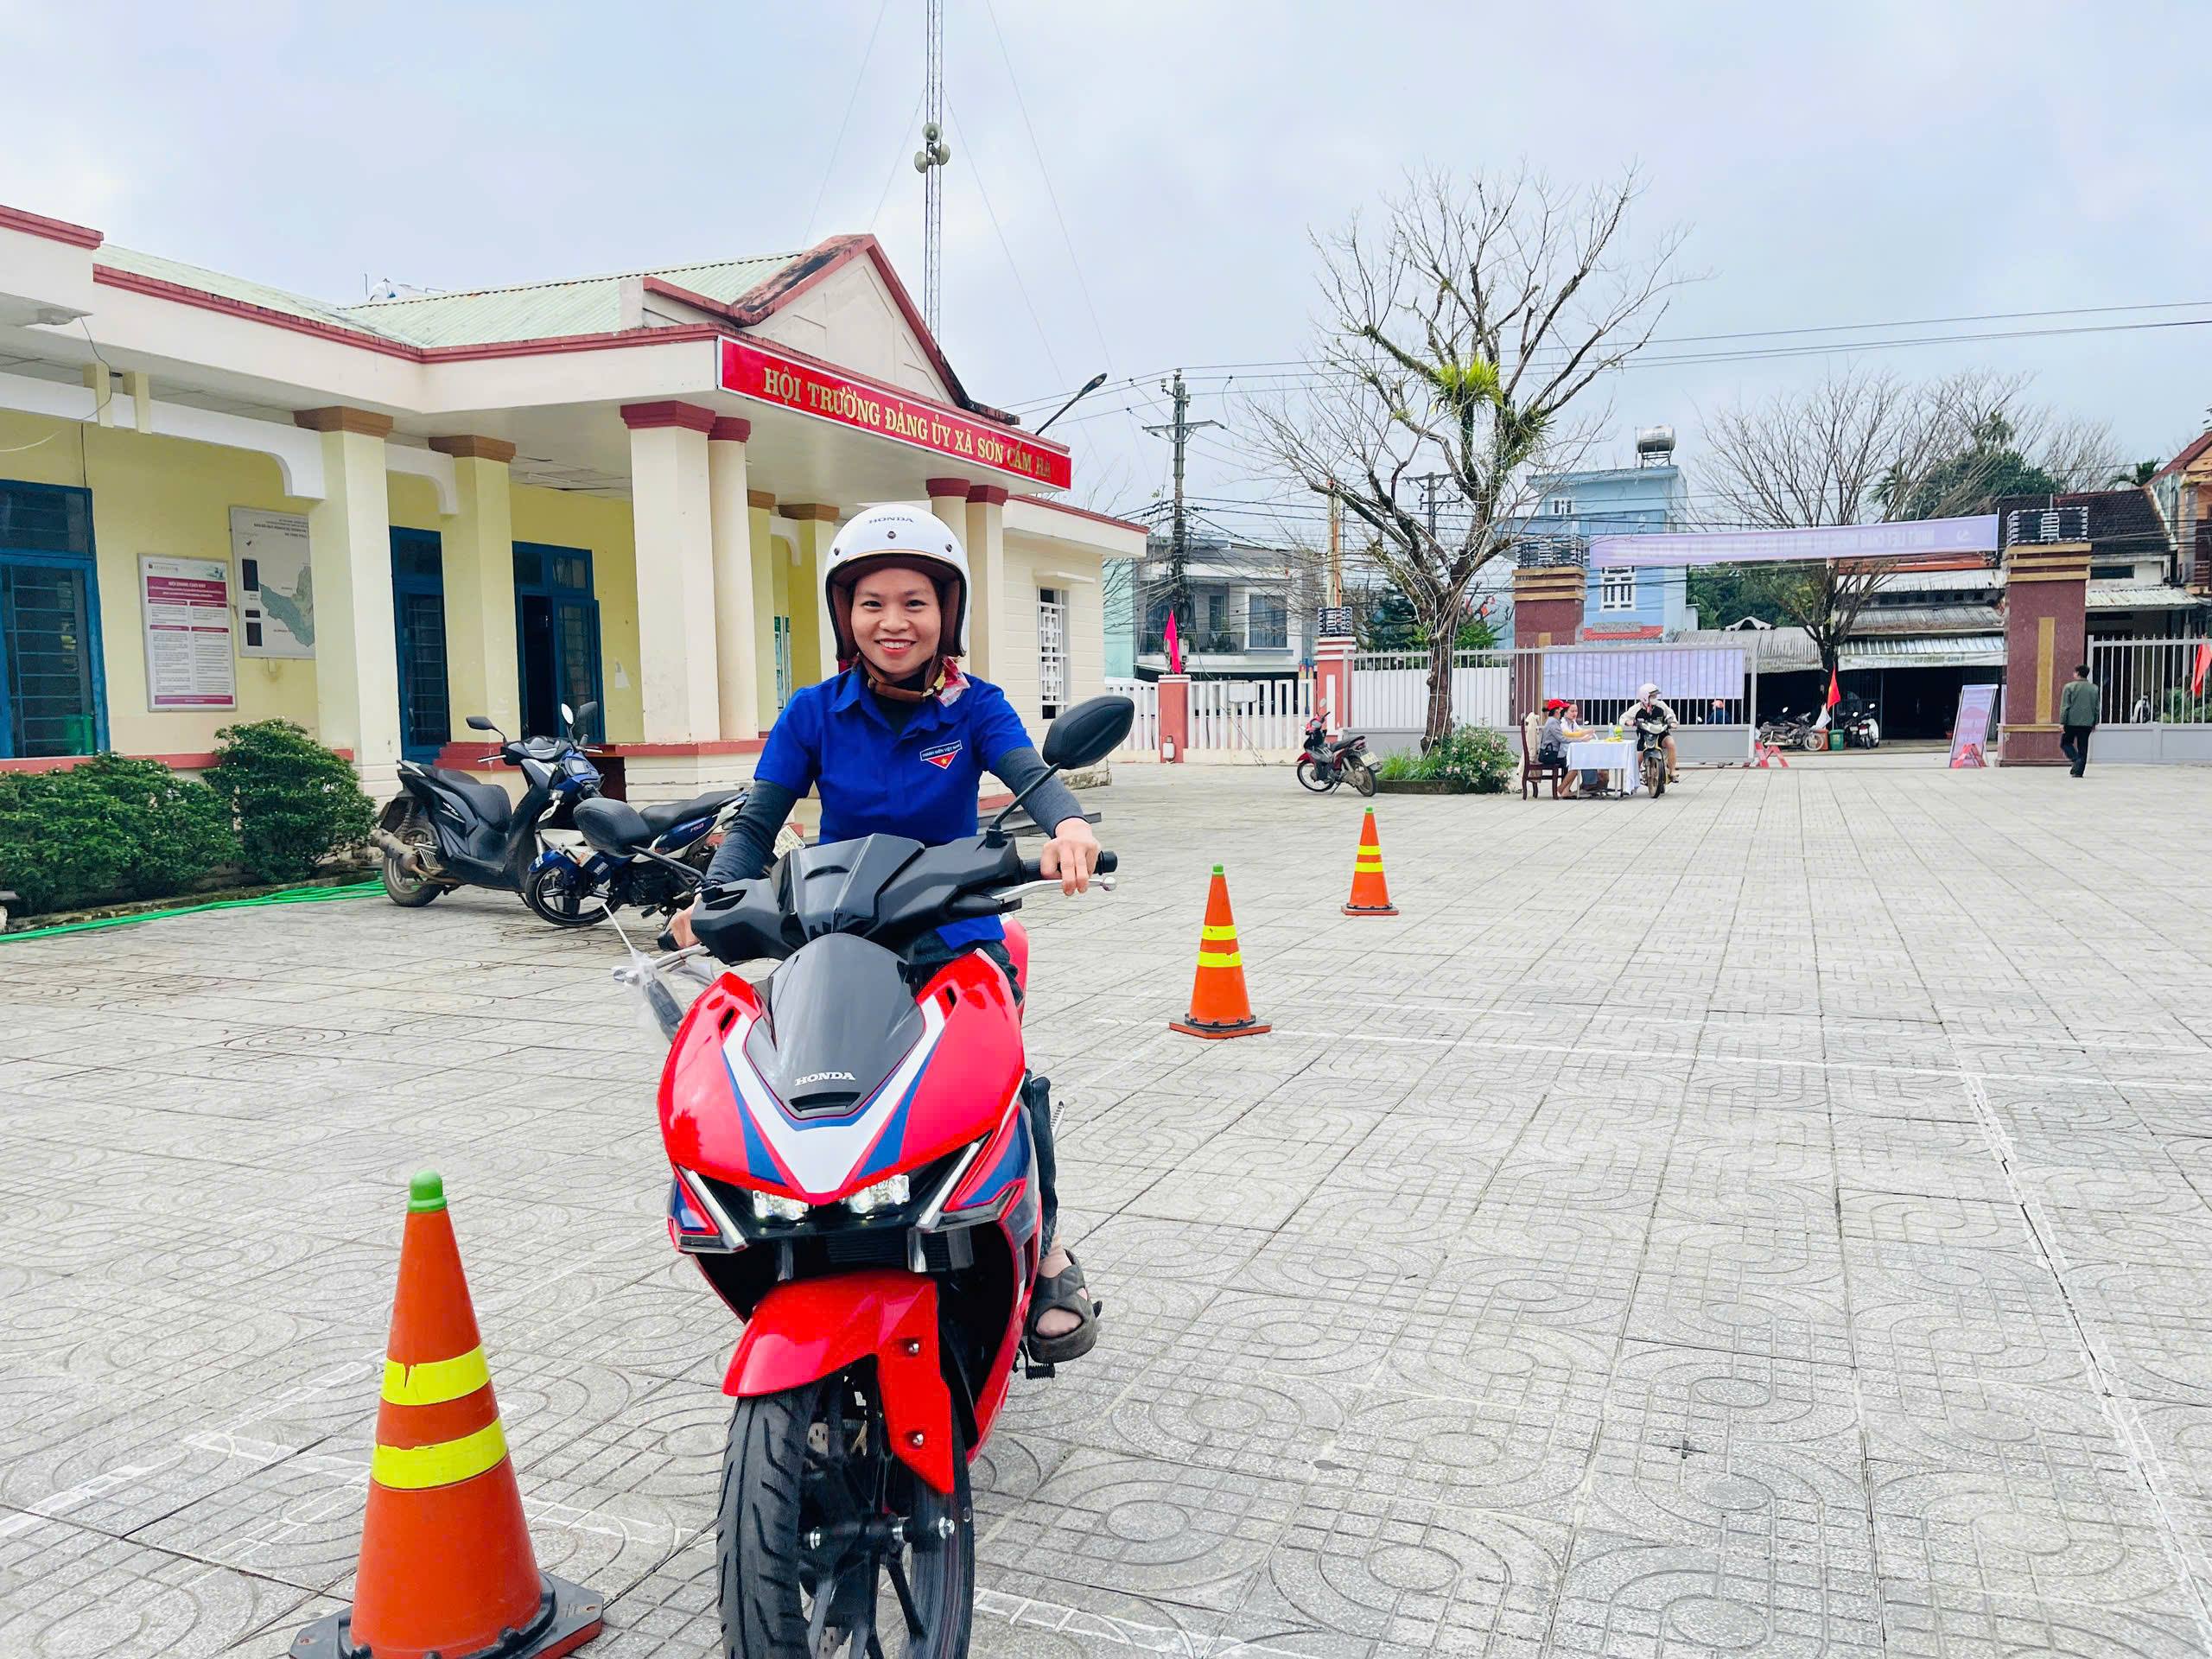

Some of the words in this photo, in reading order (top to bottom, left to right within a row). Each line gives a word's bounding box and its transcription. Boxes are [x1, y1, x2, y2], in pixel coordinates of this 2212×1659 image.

[764, 365, 801, 405] HỘI
[807, 381, 880, 427] TRƯỜNG
[885, 402, 928, 442] ĐẢNG
[931, 415, 951, 448] ỦY
[955, 429, 973, 455] XÃ
[977, 436, 1003, 464] SƠN
[795, 1071, 855, 1086] HONDA
